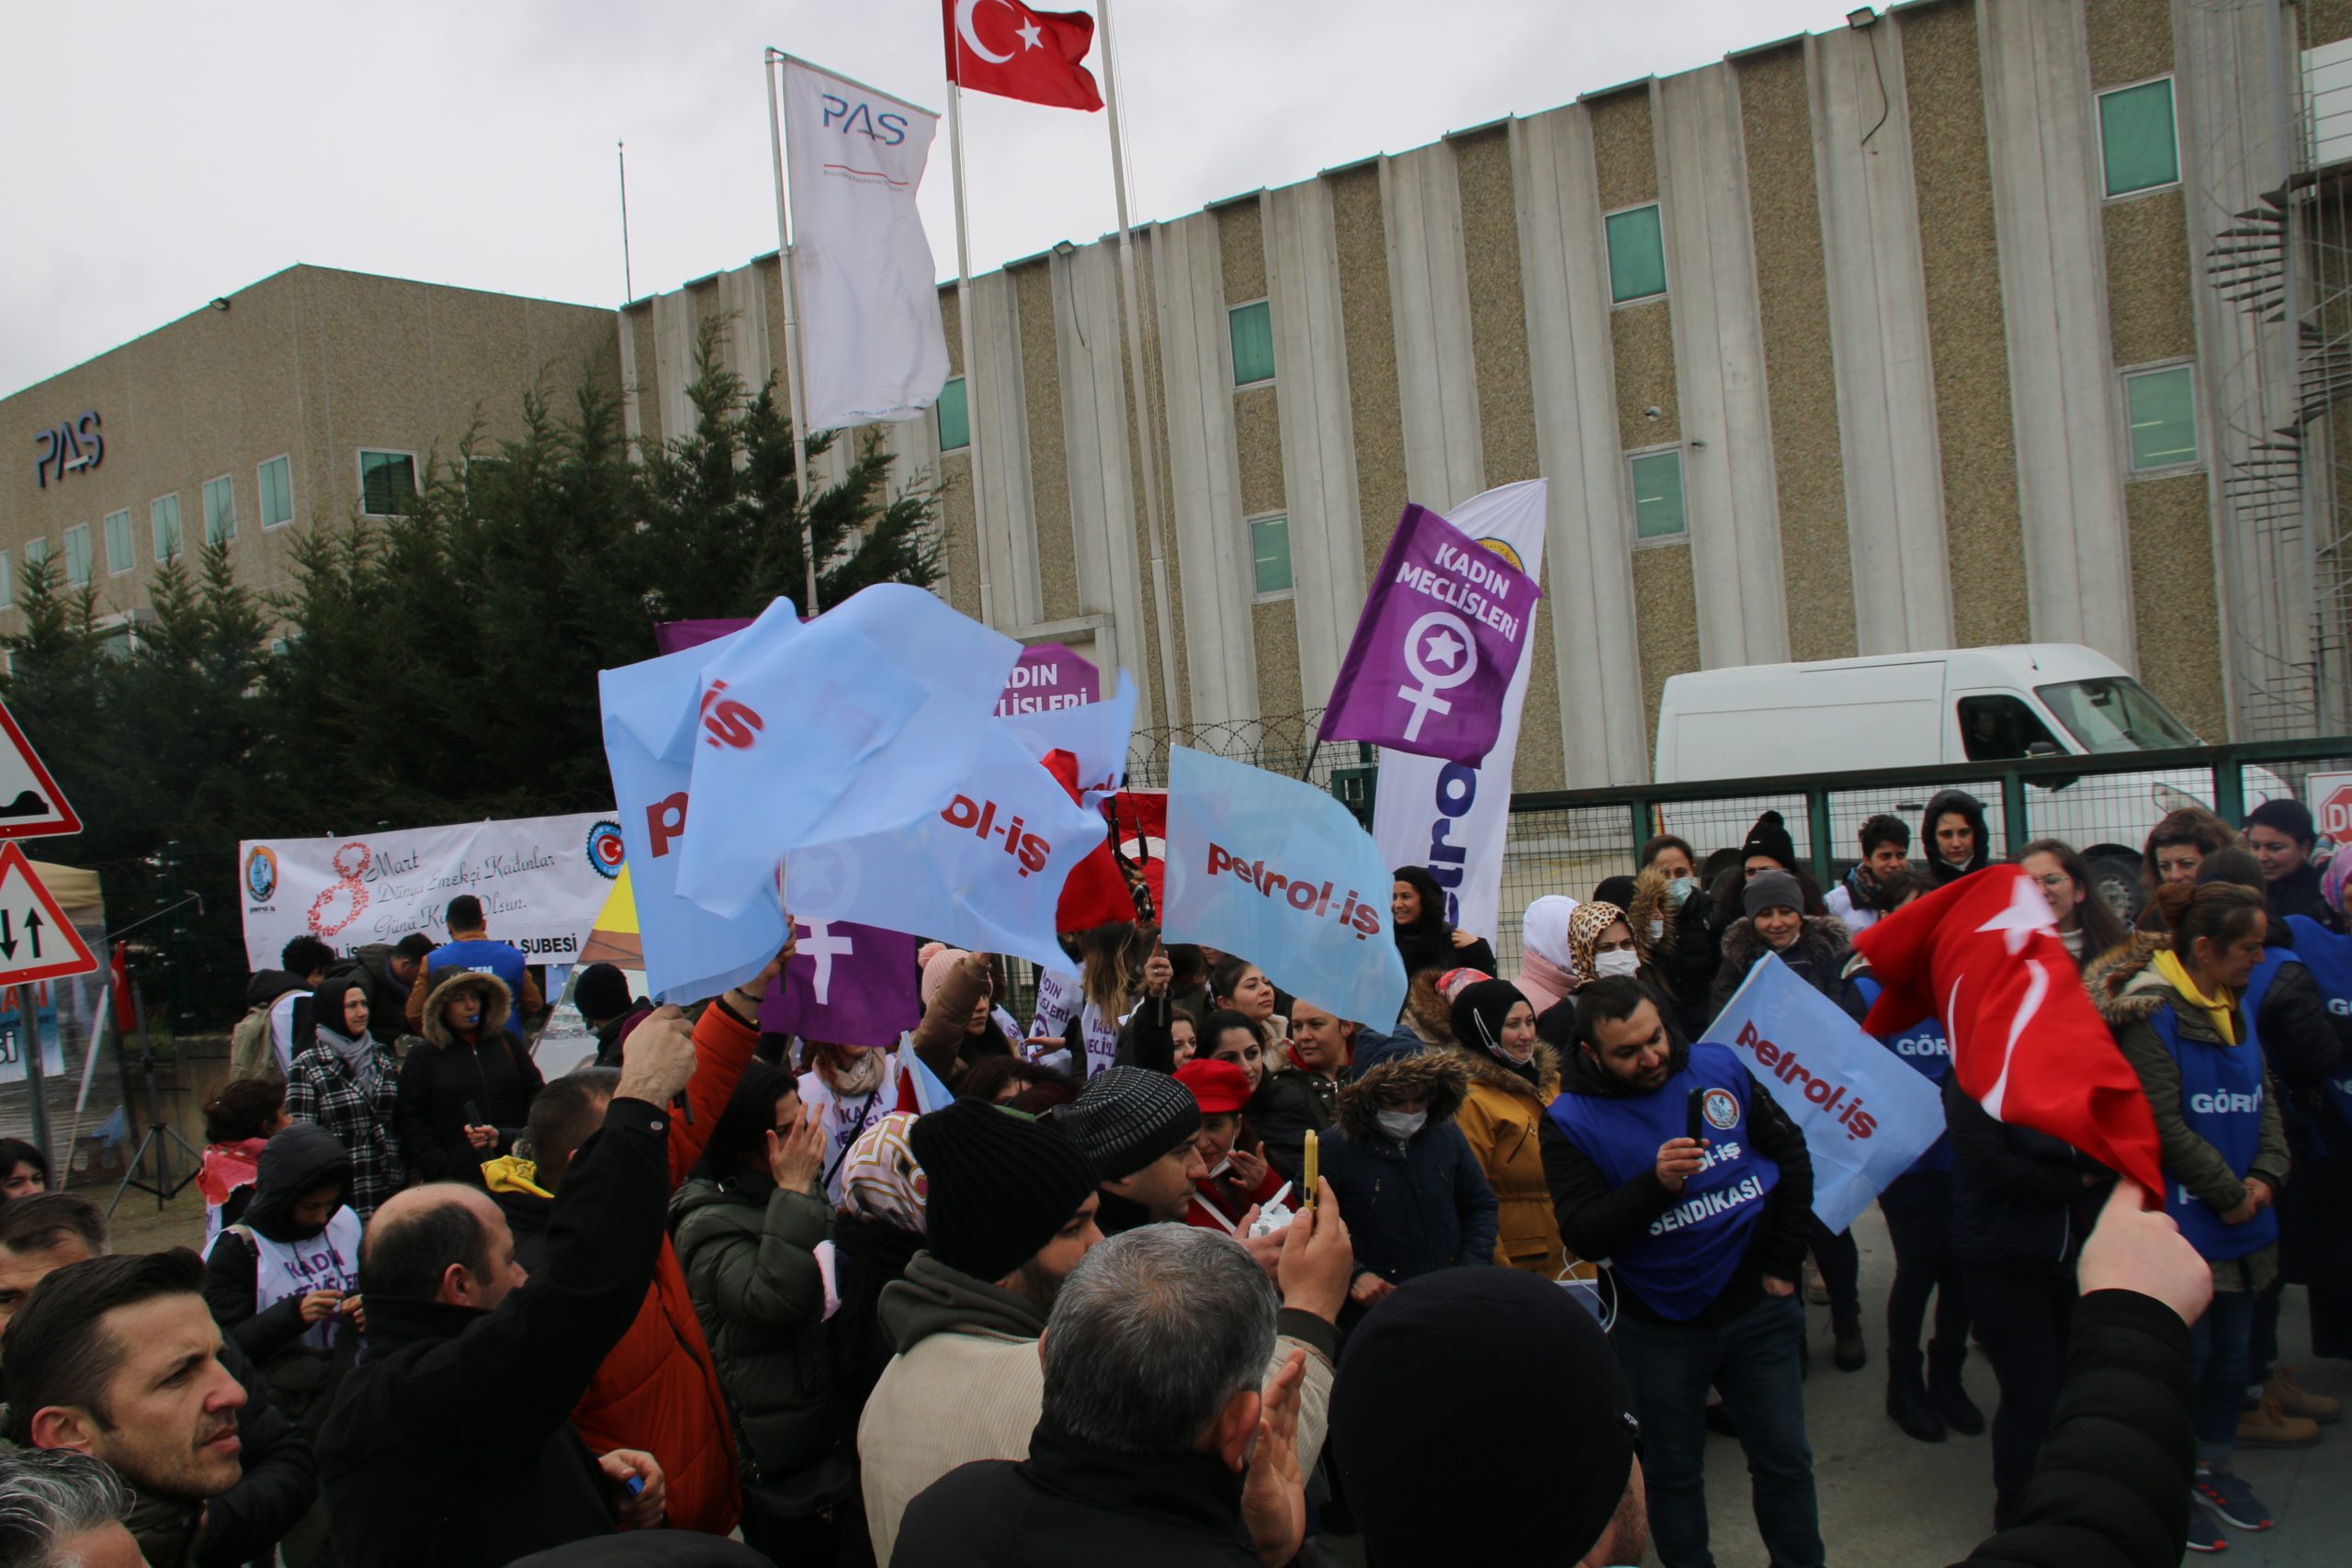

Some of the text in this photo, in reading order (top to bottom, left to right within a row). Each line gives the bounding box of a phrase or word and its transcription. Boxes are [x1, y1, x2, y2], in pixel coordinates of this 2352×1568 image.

[823, 93, 908, 145] PAS
[33, 411, 104, 489] PAS
[1434, 543, 1510, 600] KADIN
[1395, 561, 1520, 642] MECLİSLERİ
[366, 848, 420, 883] Mart
[426, 861, 481, 890] Emekçi
[483, 845, 556, 880] Kadınlar
[1207, 842, 1380, 941] petrol-iş
[374, 912, 417, 942] Günü
[520, 932, 578, 958] ŞUBESİ
[1735, 1020, 1878, 1141] petrol-iş
[1648, 1175, 1765, 1236] SENDİKASI
